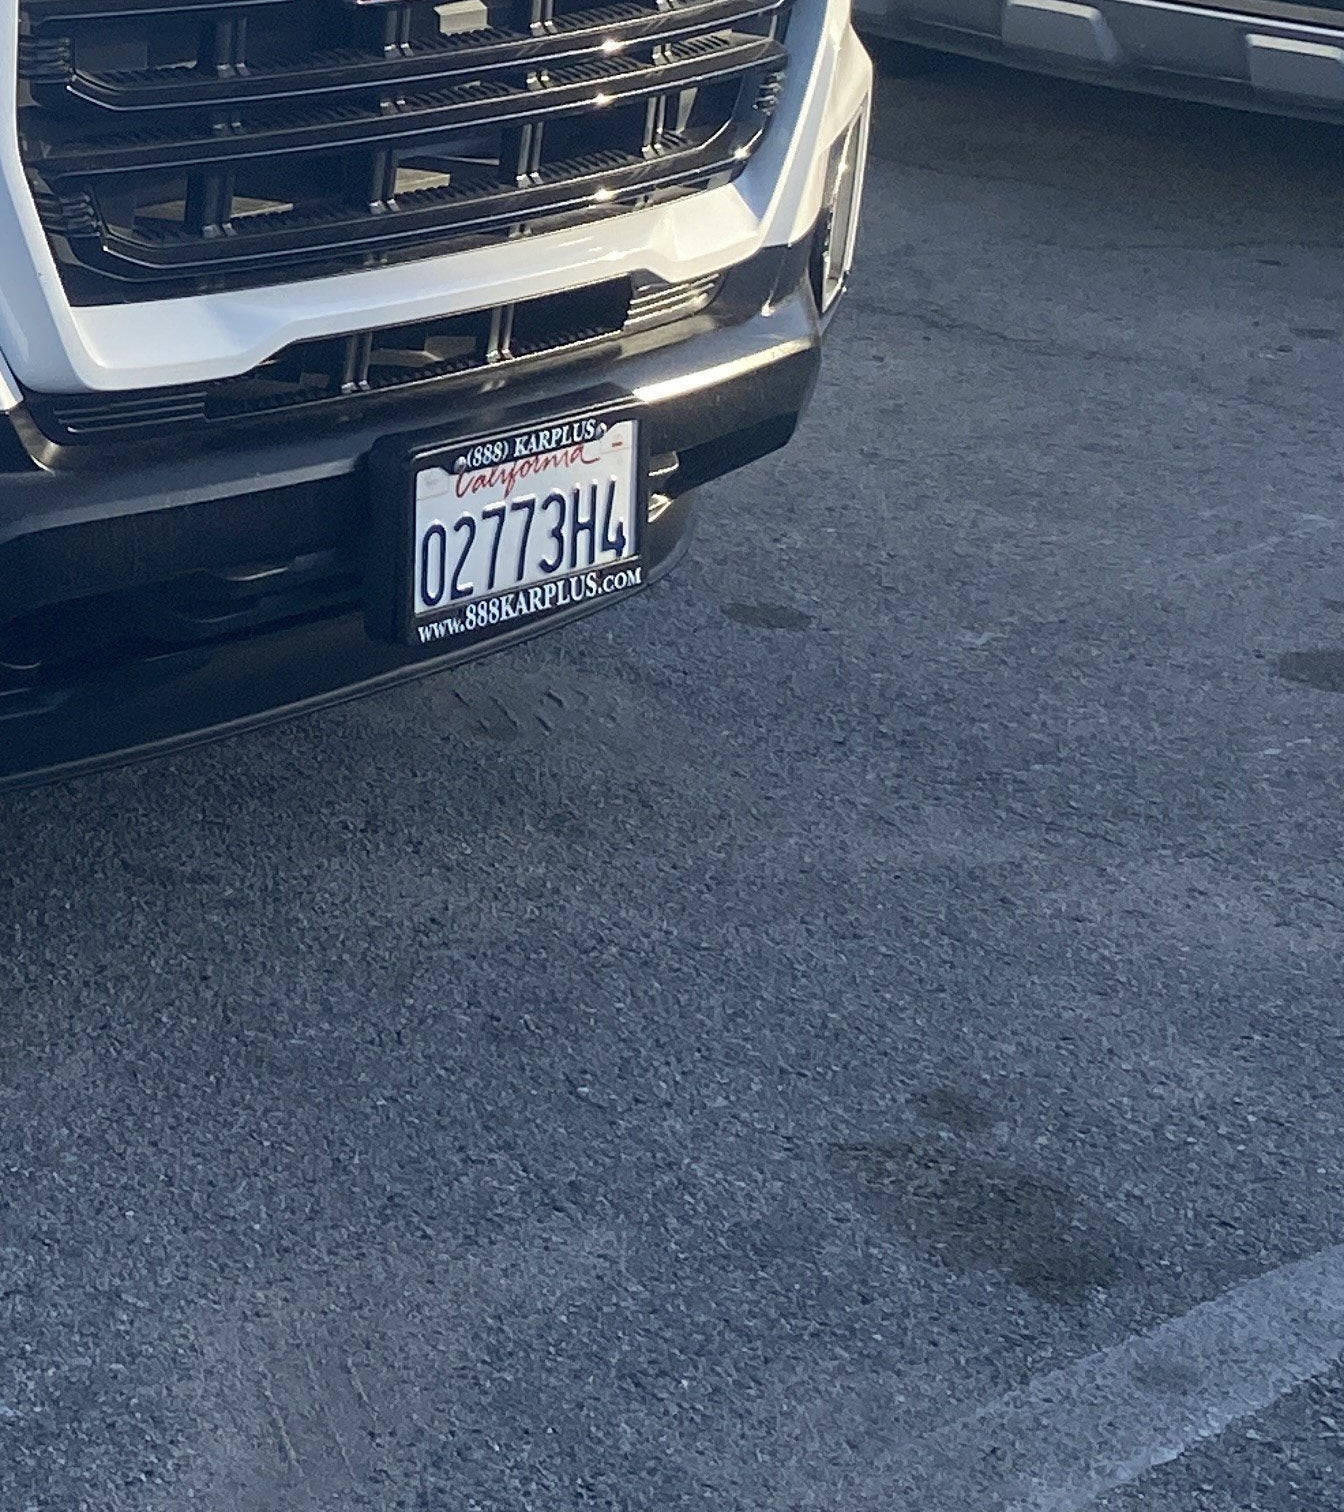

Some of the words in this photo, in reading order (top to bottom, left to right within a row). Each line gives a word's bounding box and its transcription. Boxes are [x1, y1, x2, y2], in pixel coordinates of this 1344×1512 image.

[466, 440, 510, 469] (888)
[513, 418, 597, 458] KARPLUS
[420, 474, 628, 607] 02773H4
